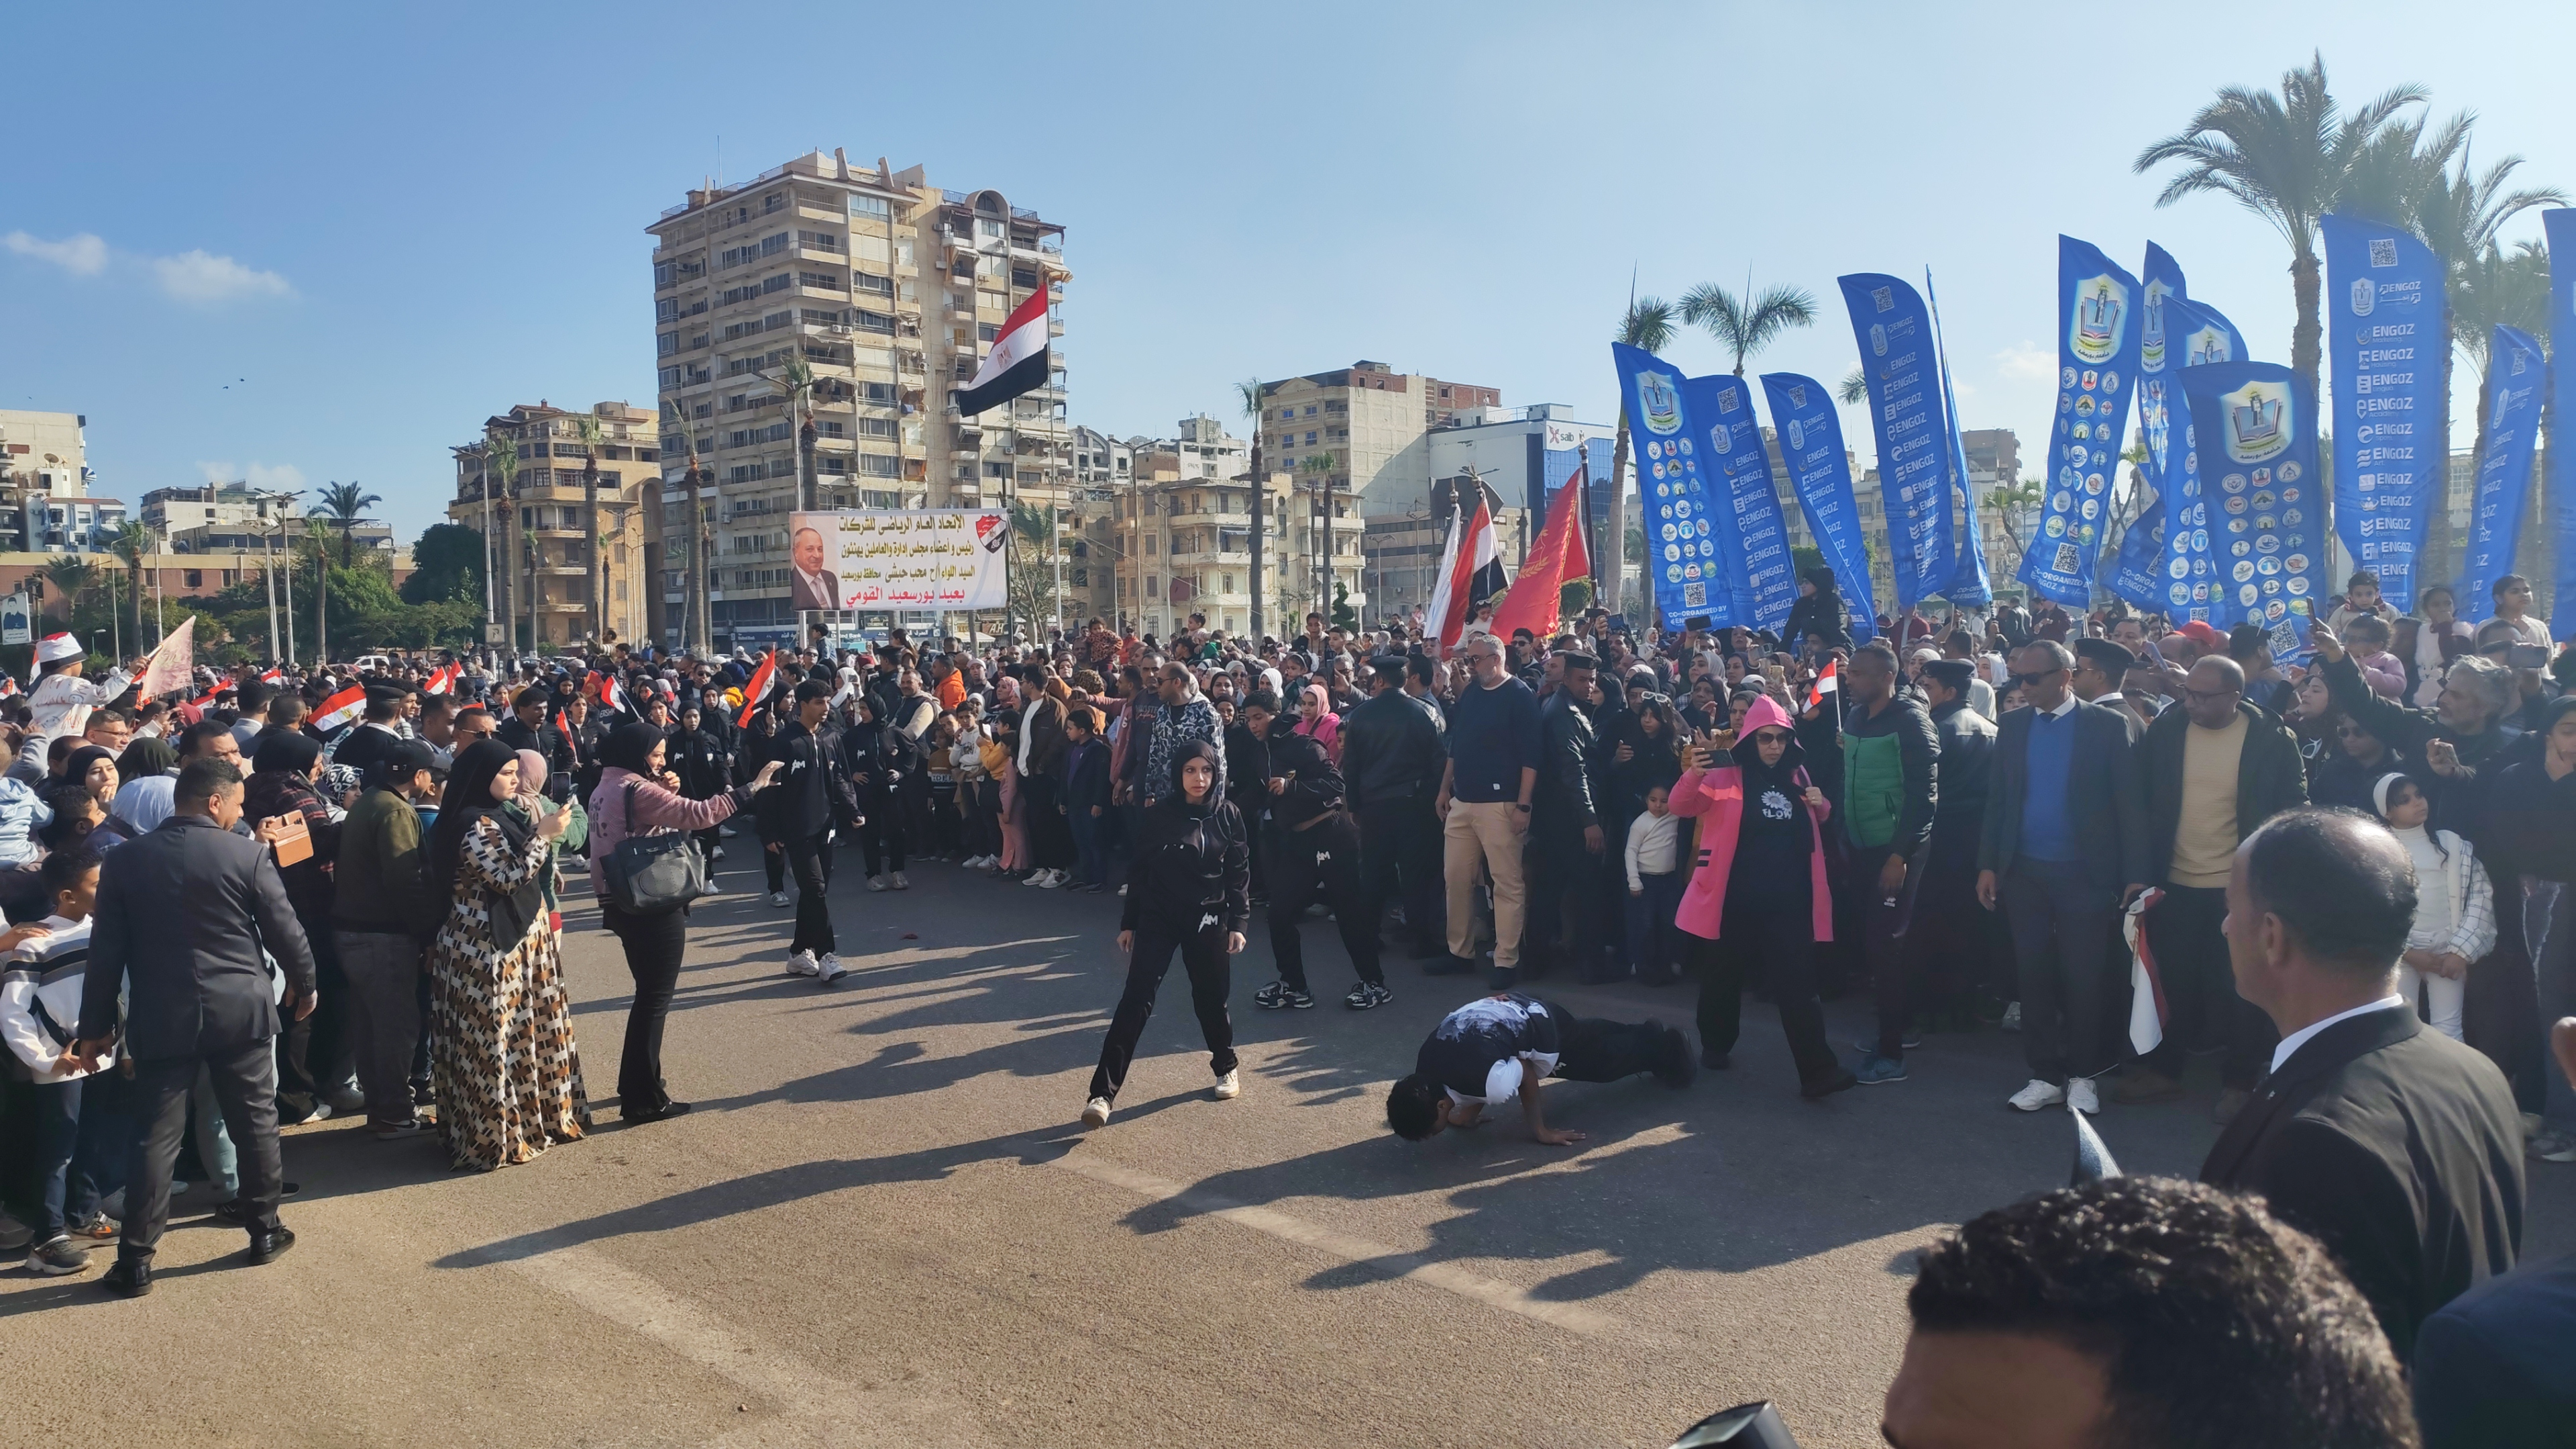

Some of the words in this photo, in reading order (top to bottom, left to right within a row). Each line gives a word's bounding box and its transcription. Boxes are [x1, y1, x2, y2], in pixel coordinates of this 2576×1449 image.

[839, 515, 875, 535] للشركات
[915, 514, 935, 533] العام
[841, 542, 863, 558] يهنئون
[865, 541, 892, 558] والعاملين
[894, 541, 908, 557] إدارة
[910, 541, 928, 557] مجلس
[930, 538, 950, 555] أعضاء
[950, 545, 955, 555] و
[957, 539, 974, 556] رئيس
[841, 568, 862, 582] بورسعيد
[863, 568, 881, 579] محافظ
[885, 562, 908, 583] حبشى
[910, 566, 926, 582] محب
[942, 564, 957, 581] اللواء
[959, 564, 975, 580] السيد
[888, 588, 934, 604] بورسعيد
[939, 588, 965, 604] بعيد
[1668, 607, 1717, 617] CO-ORGANIZED
[1316, 851, 1331, 867] AM
[1198, 911, 1218, 933] AM
